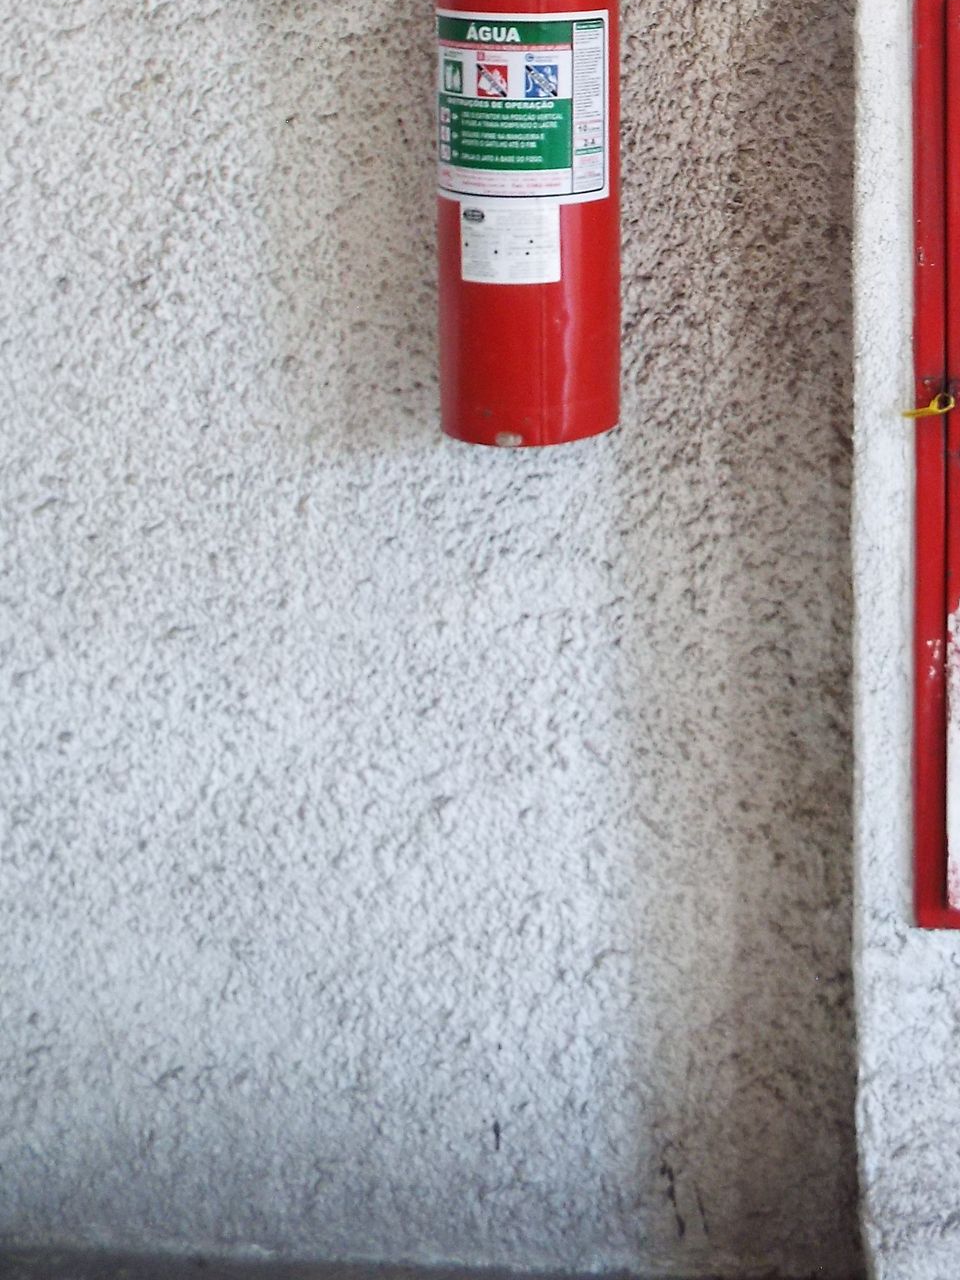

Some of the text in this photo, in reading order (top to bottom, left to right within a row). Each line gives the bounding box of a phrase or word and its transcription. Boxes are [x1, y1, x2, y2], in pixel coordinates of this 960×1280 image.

[466, 22, 521, 43] ÁGUA
[491, 101, 503, 109] DE
[504, 101, 555, 110] OPERAÇÃO
